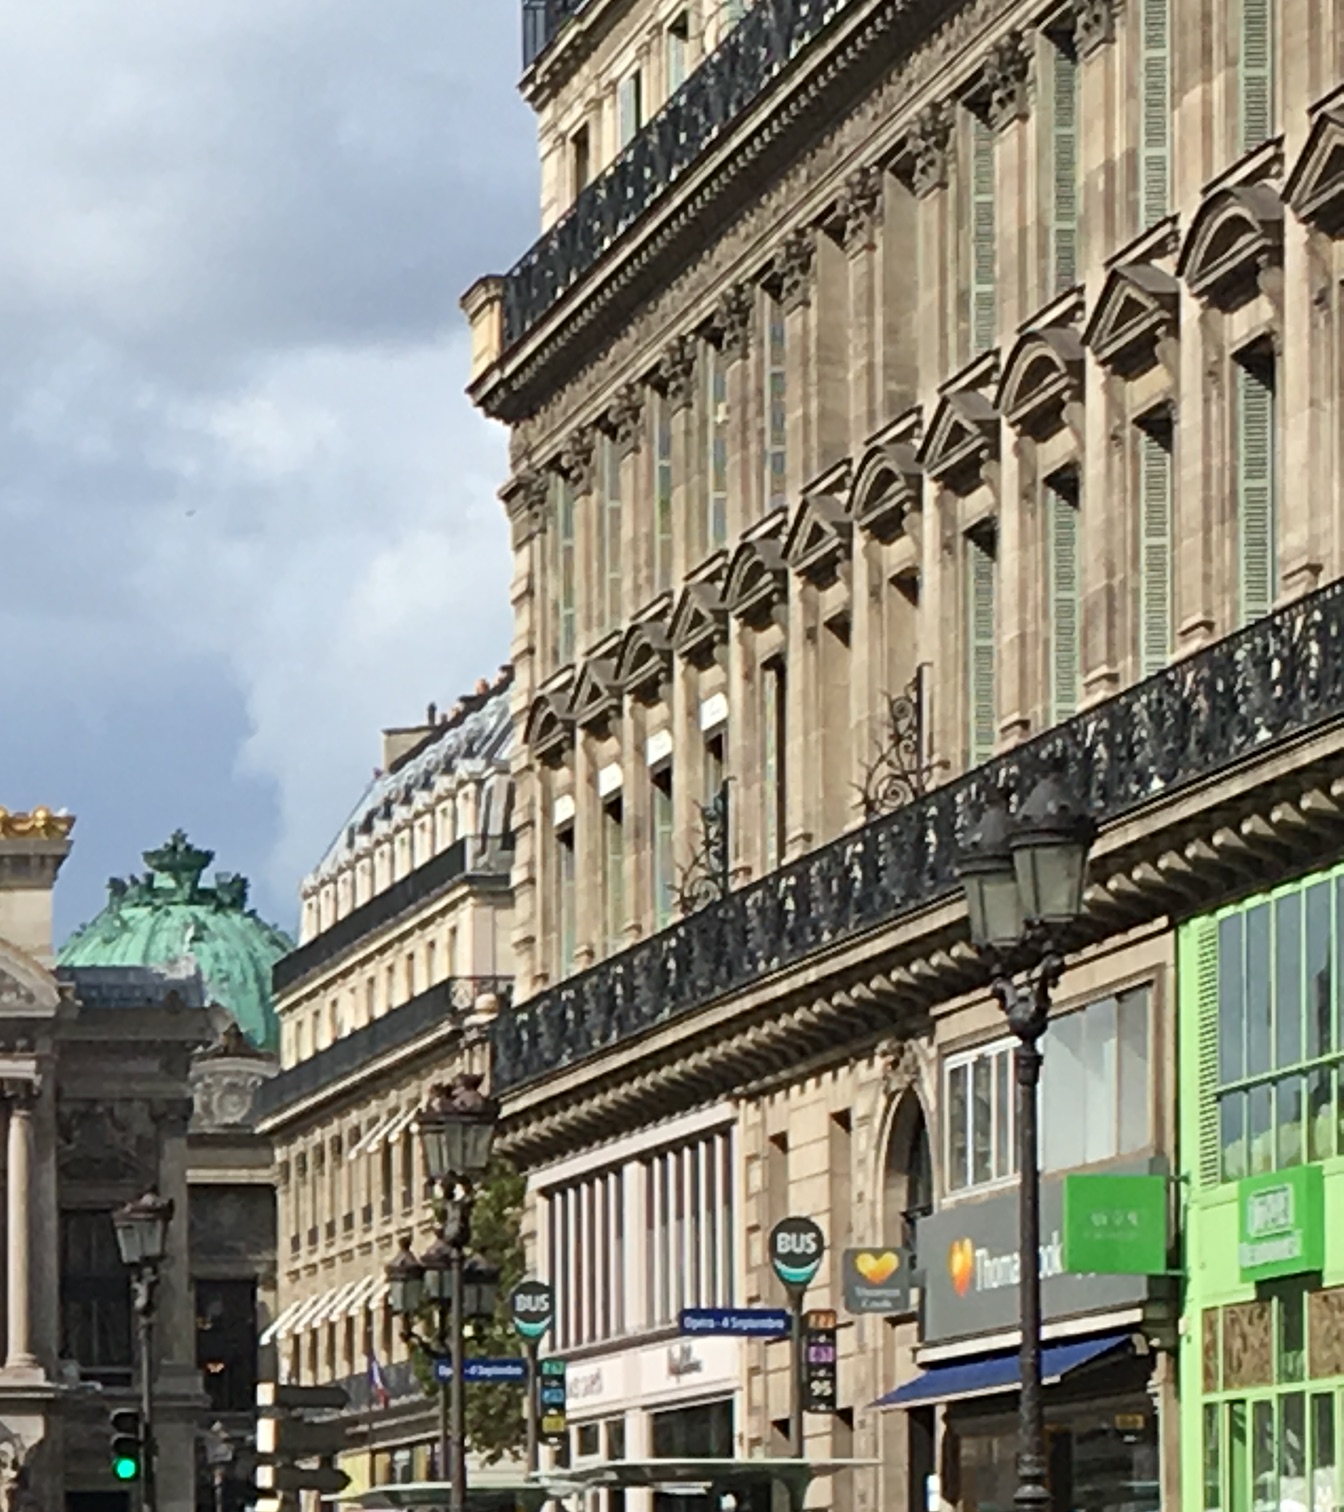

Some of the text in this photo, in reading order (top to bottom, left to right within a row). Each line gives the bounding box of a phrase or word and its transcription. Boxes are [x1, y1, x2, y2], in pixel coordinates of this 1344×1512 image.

[777, 1233, 817, 1253] BUS
[975, 1247, 1021, 1291] Thoma
[515, 1293, 550, 1312] BUS
[731, 1316, 785, 1331] Septembre
[810, 1380, 833, 1396] 95
